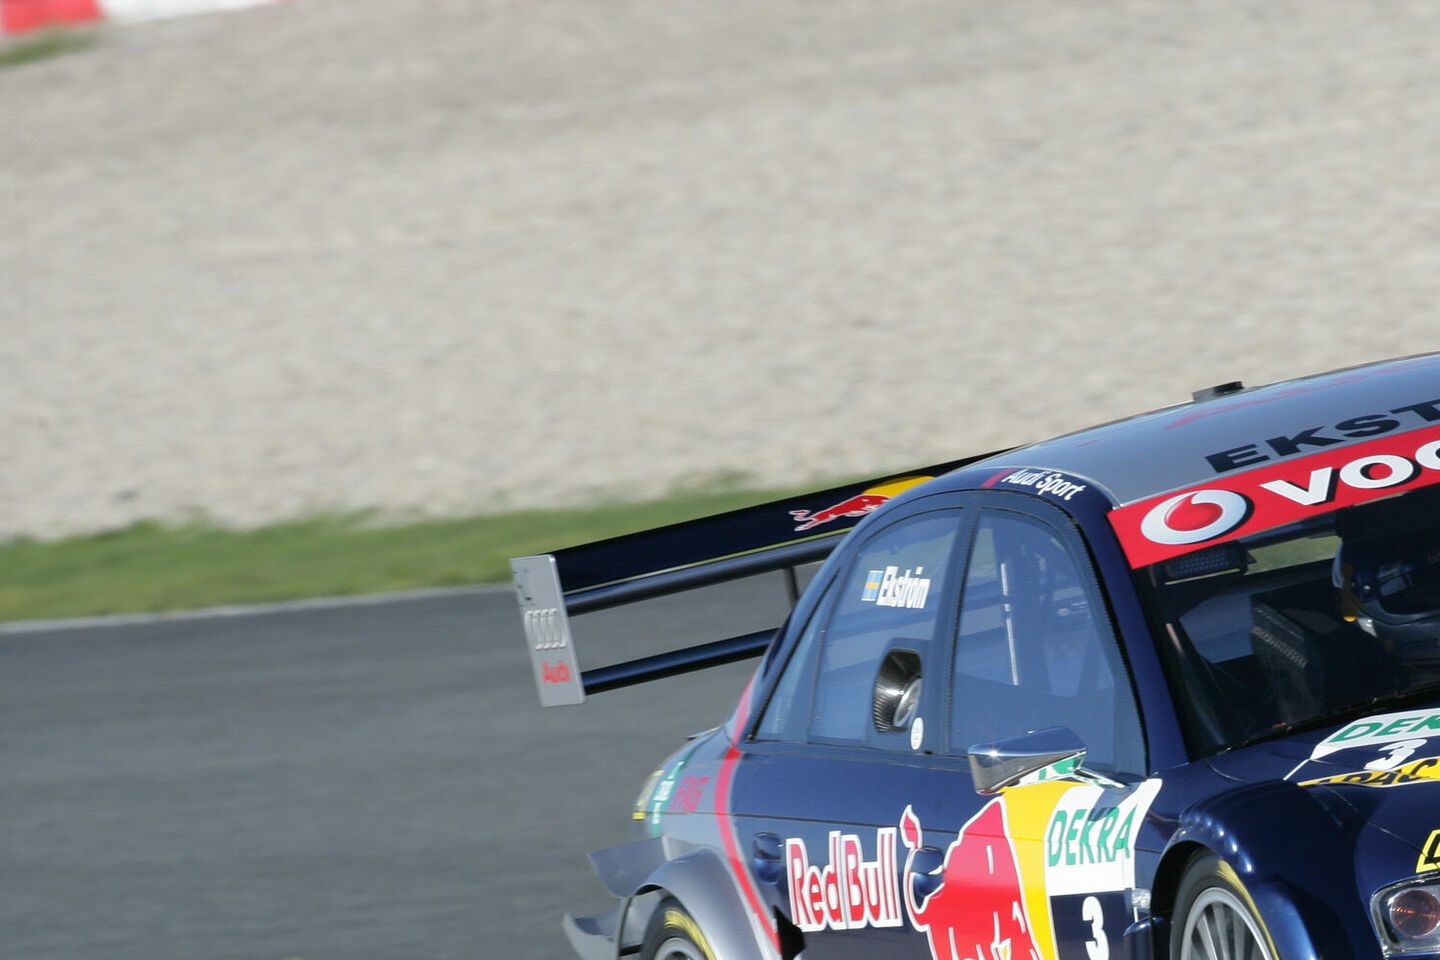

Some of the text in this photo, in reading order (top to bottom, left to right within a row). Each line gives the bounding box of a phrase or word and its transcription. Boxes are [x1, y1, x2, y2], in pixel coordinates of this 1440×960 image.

[1001, 468, 1086, 500] Audi Sport
[876, 566, 931, 609] Ekström
[1363, 739, 1428, 771] 3
[1048, 805, 1138, 867] DEKRA
[787, 828, 902, 931] Red Bull
